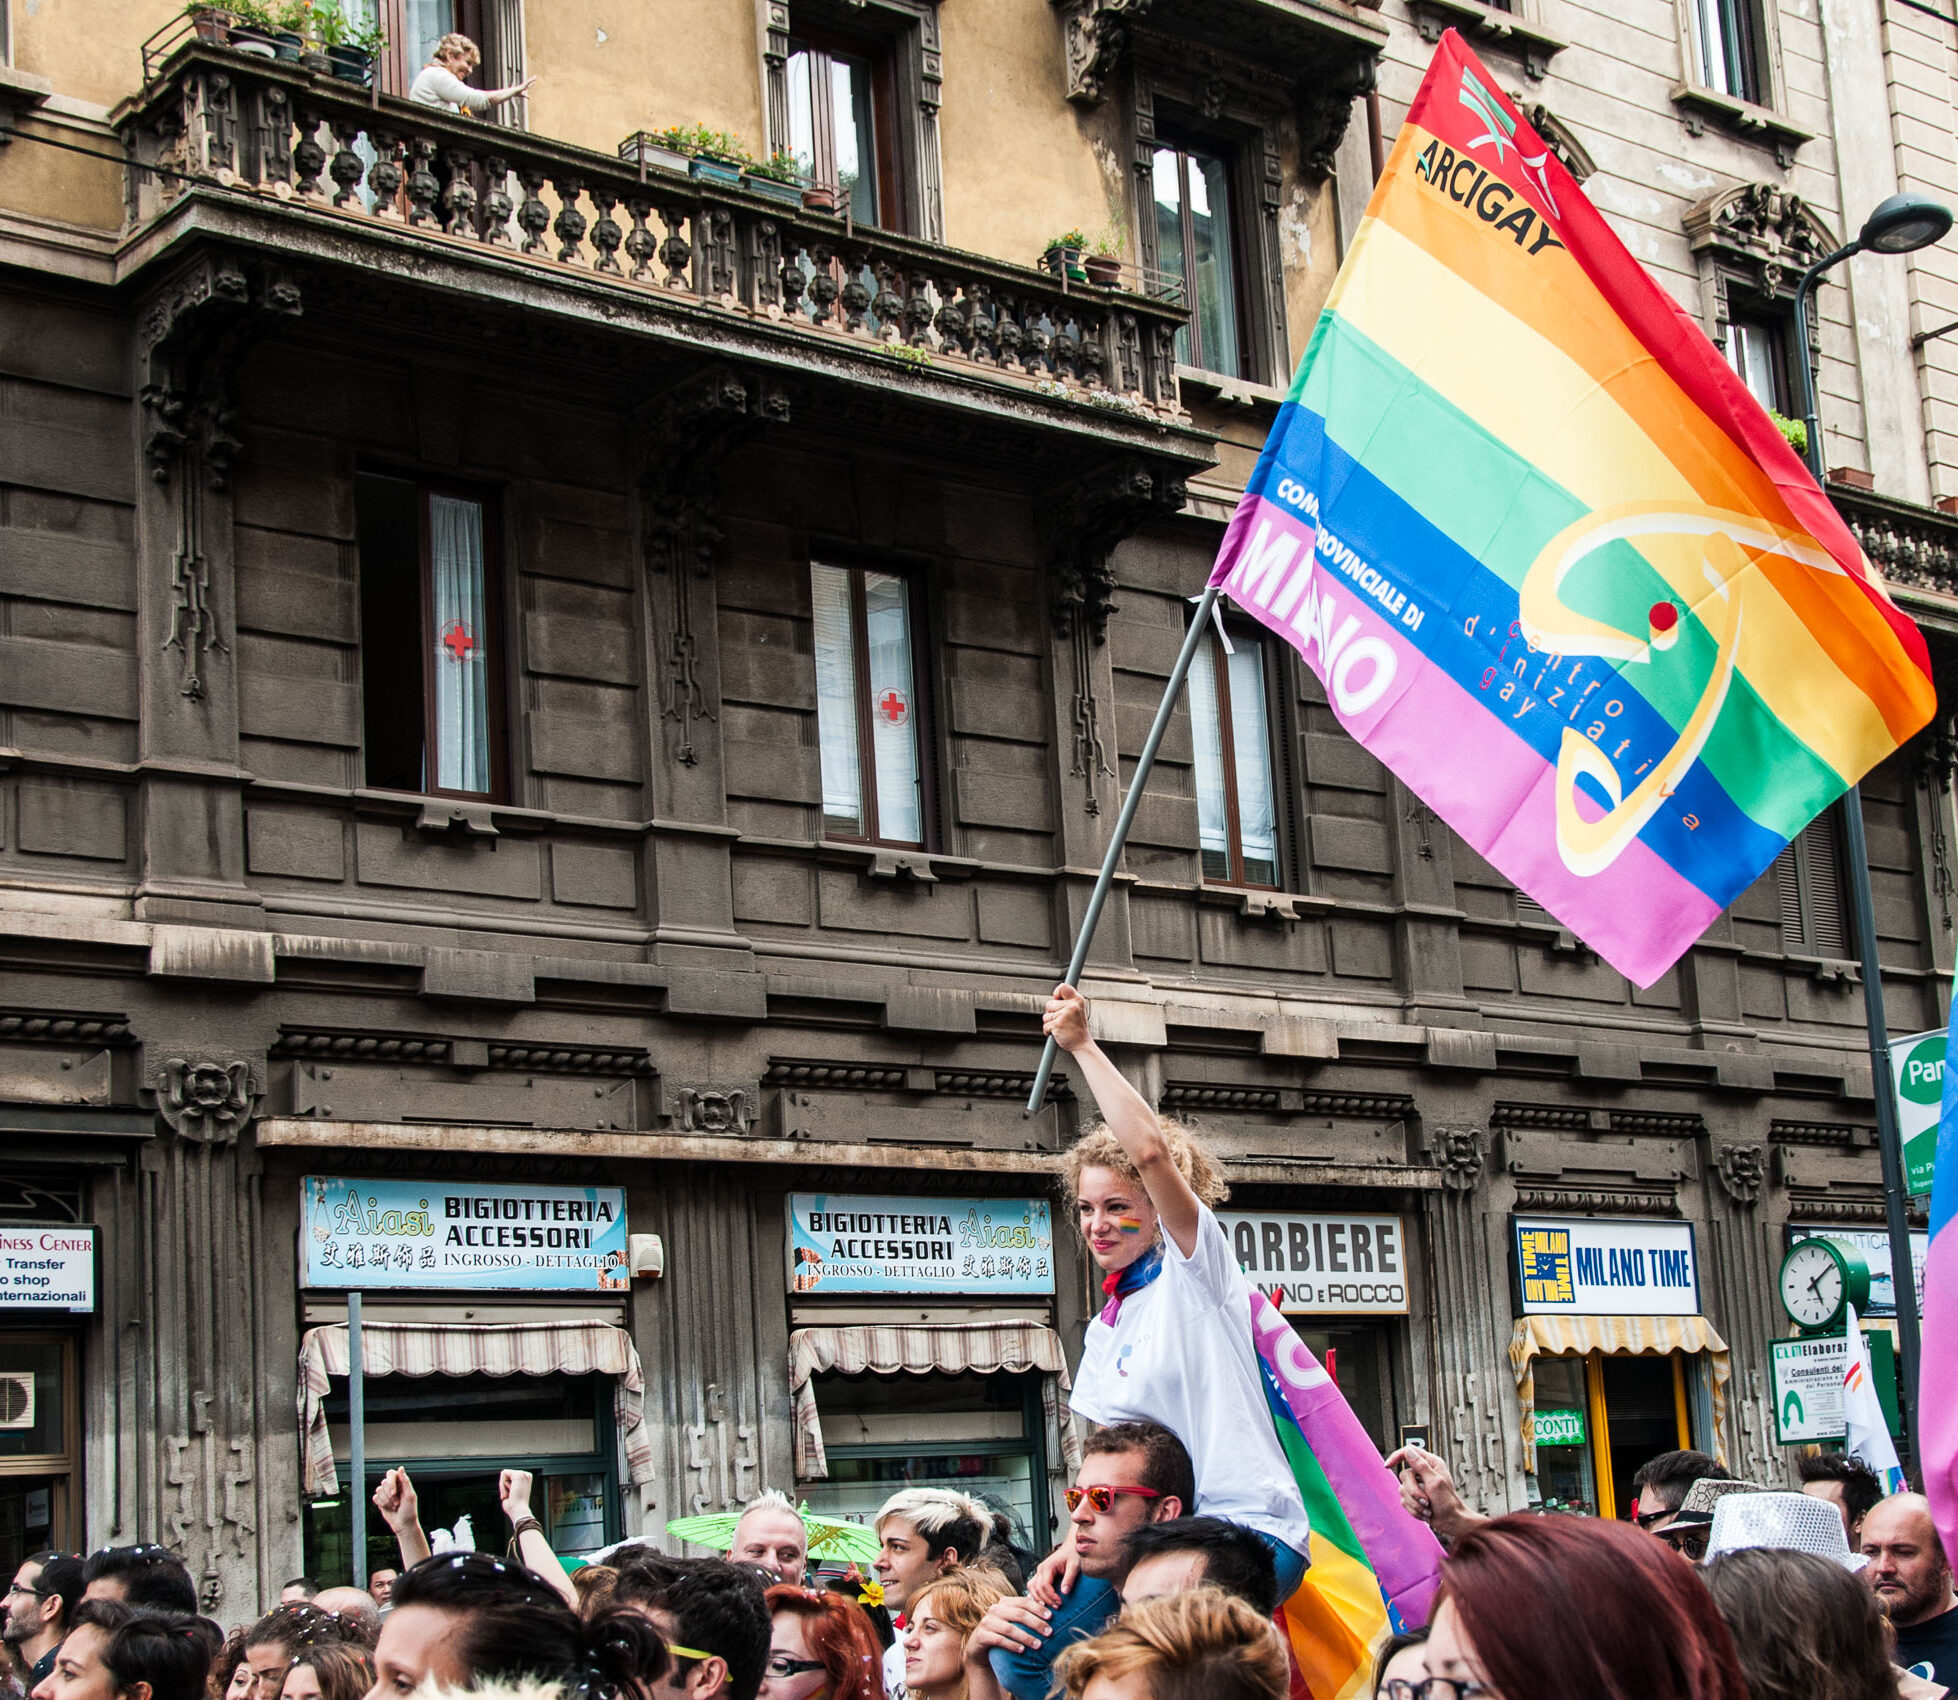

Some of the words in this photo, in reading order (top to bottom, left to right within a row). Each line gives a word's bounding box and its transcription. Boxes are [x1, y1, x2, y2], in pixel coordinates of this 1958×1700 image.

[1415, 139, 1566, 256] ARCIGAY
[1316, 523, 1408, 616] ROVINCIALE
[1401, 601, 1426, 632] DI
[1479, 666, 1536, 718] gay
[1911, 1165, 1925, 1176] via
[335, 1189, 435, 1236] Aiasi
[444, 1196, 615, 1222] BIGIOTTERIA
[809, 1212, 953, 1236] BIGIOTTERIA
[958, 1208, 1037, 1249] Aiasi
[444, 1225, 594, 1249] ACCESSORI
[1217, 1220, 1397, 1273] ARBIERE
[1535, 1231, 1568, 1254] MILANO
[444, 1253, 522, 1268] INGROSSO
[535, 1254, 621, 1269] DETTAGLIO
[830, 1239, 954, 1261] ACCESSORI
[1521, 1231, 1538, 1278] TIME
[5, 1258, 66, 1270] Transfer
[806, 1263, 873, 1277] INGROSSO
[884, 1264, 956, 1279] DETTAGLIO
[1575, 1247, 1646, 1287] MILANO
[1648, 1249, 1691, 1288] TIME
[13, 1274, 51, 1288] shop
[1555, 1255, 1573, 1302] TIME
[0, 1290, 87, 1302] ternazionali
[1317, 1289, 1325, 1303] E
[1328, 1283, 1404, 1304] ROCCO
[1791, 1365, 1830, 1377] Consulenti
[1832, 1364, 1843, 1373] del
